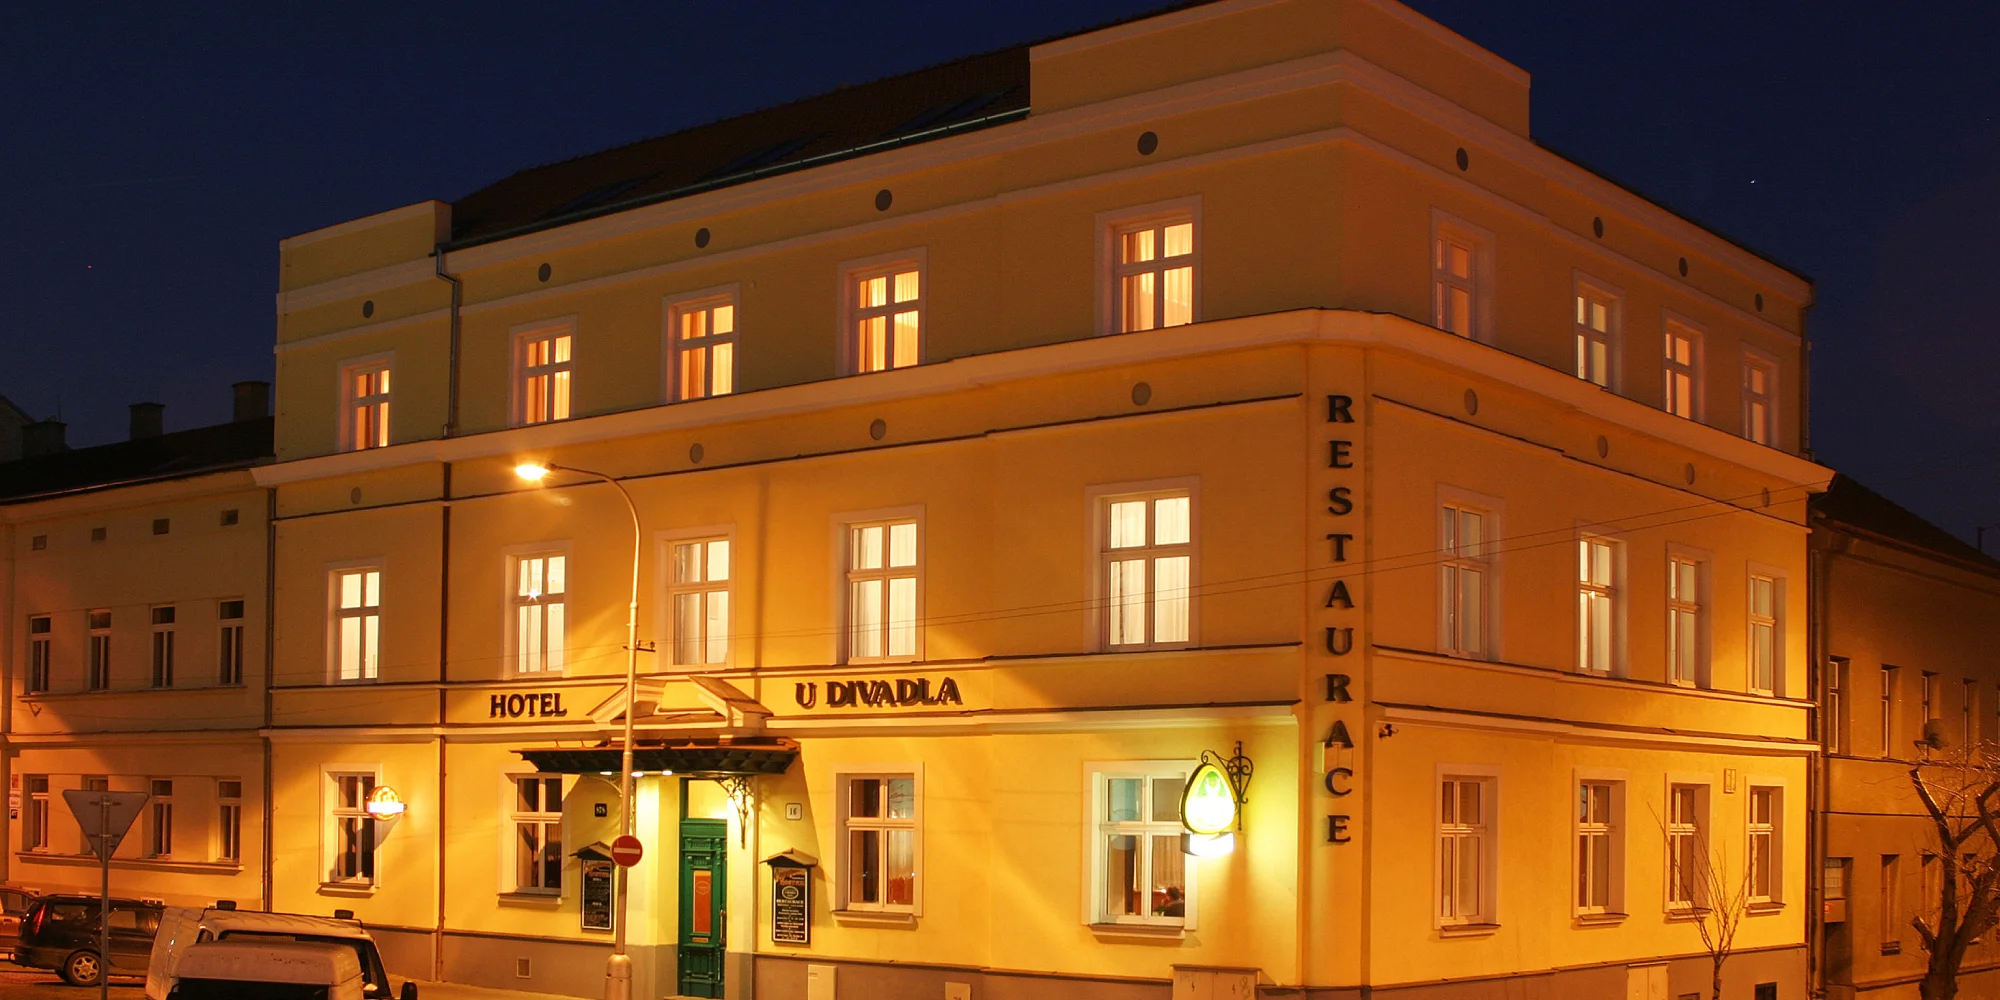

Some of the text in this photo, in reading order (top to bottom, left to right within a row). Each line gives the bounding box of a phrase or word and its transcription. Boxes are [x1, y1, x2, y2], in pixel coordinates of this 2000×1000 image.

[1325, 394, 1355, 844] RESTAURACE
[489, 677, 963, 718] HOTEL U DIVADLA
[789, 807, 798, 816] 16
